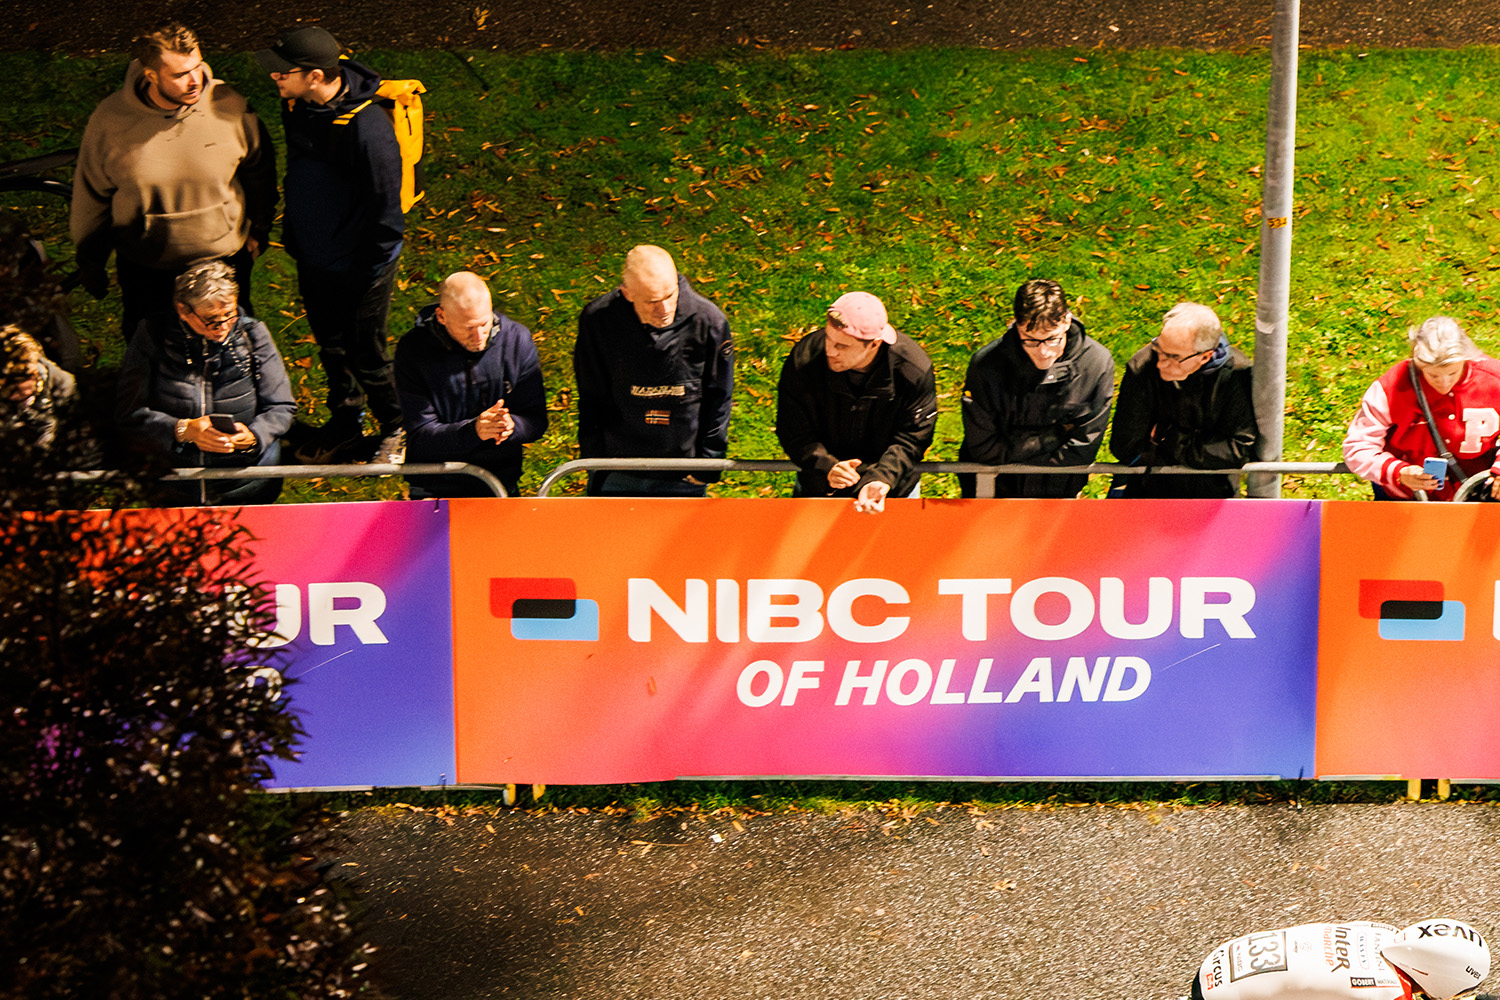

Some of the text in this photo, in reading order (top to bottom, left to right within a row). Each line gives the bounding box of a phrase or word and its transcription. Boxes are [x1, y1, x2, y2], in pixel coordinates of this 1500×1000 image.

[1459, 407, 1500, 454] P
[627, 576, 1257, 644] NIBC TOUR
[737, 655, 1153, 708] OF HOLLAND
[1248, 932, 1281, 972] 133
[1417, 923, 1483, 948] uvex
[1465, 965, 1482, 980] uvex
